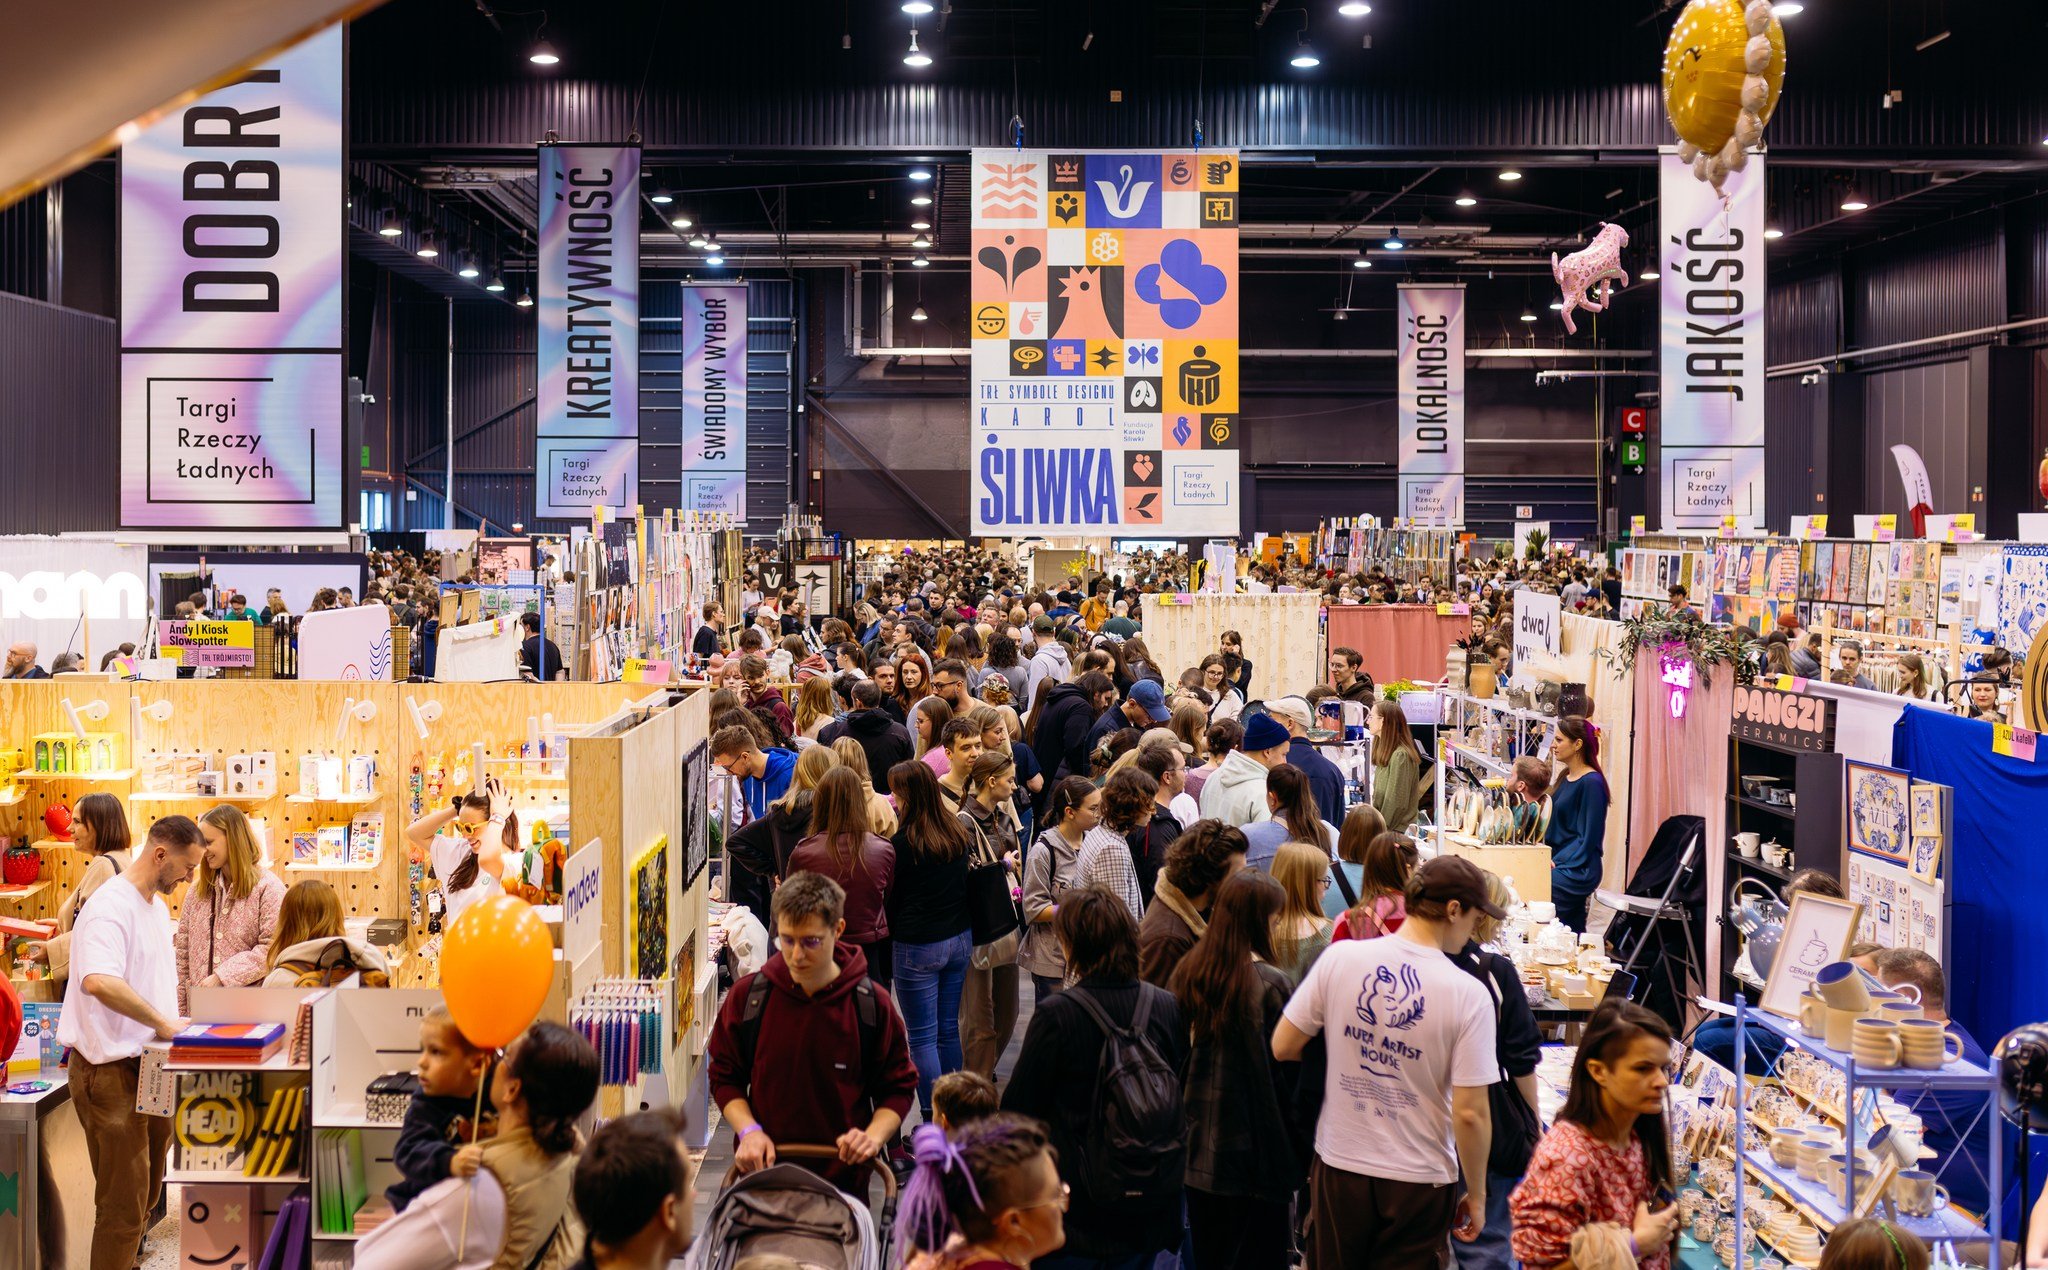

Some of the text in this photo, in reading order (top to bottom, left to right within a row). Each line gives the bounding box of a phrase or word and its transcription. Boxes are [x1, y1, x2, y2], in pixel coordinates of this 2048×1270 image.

[555, 168, 613, 418] KREATYWNOŚĆ
[1671, 228, 1744, 401] JAKOŚĆ
[698, 298, 727, 460] ŚWIADOMY WYBÓR
[1408, 315, 1447, 454] LOKALNOŚĆ
[981, 384, 1114, 399] TRŁ SYMBOLE DESIGNU
[177, 397, 236, 423] Targi
[981, 407, 1114, 426] KAROL
[1627, 412, 1641, 428] C
[178, 428, 262, 454] Rzeczy
[1628, 446, 1640, 460] B
[177, 457, 274, 484] Ładnych
[562, 458, 590, 470] Targi
[562, 472, 602, 485] Rzeczy
[981, 433, 1118, 525] ŚLIWKA
[1183, 471, 1203, 480] Targi
[1687, 468, 1715, 480] Targi
[562, 486, 608, 498] Ładnych
[698, 483, 716, 492] Targi
[1183, 481, 1211, 489] Rzeczy
[1415, 487, 1433, 495] Targi
[1687, 482, 1727, 494] Rzeczy
[698, 493, 724, 501] Rzeczy
[1183, 490, 1215, 499] Ładnych
[1415, 496, 1441, 504] Rzeczy
[1687, 495, 1733, 508] Ładnych
[1521, 605, 1544, 636] dwa
[169, 624, 193, 636] Andy
[202, 624, 228, 634] Kiosk
[169, 636, 228, 647] Slowspotter
[1732, 686, 1825, 734] PANGZI
[1731, 723, 1823, 750] CERAMICS
[567, 866, 599, 924] mideer
[1344, 1024, 1374, 1046] AURA
[1361, 1045, 1401, 1071] HOUSE
[181, 1109, 238, 1135] HEAD
